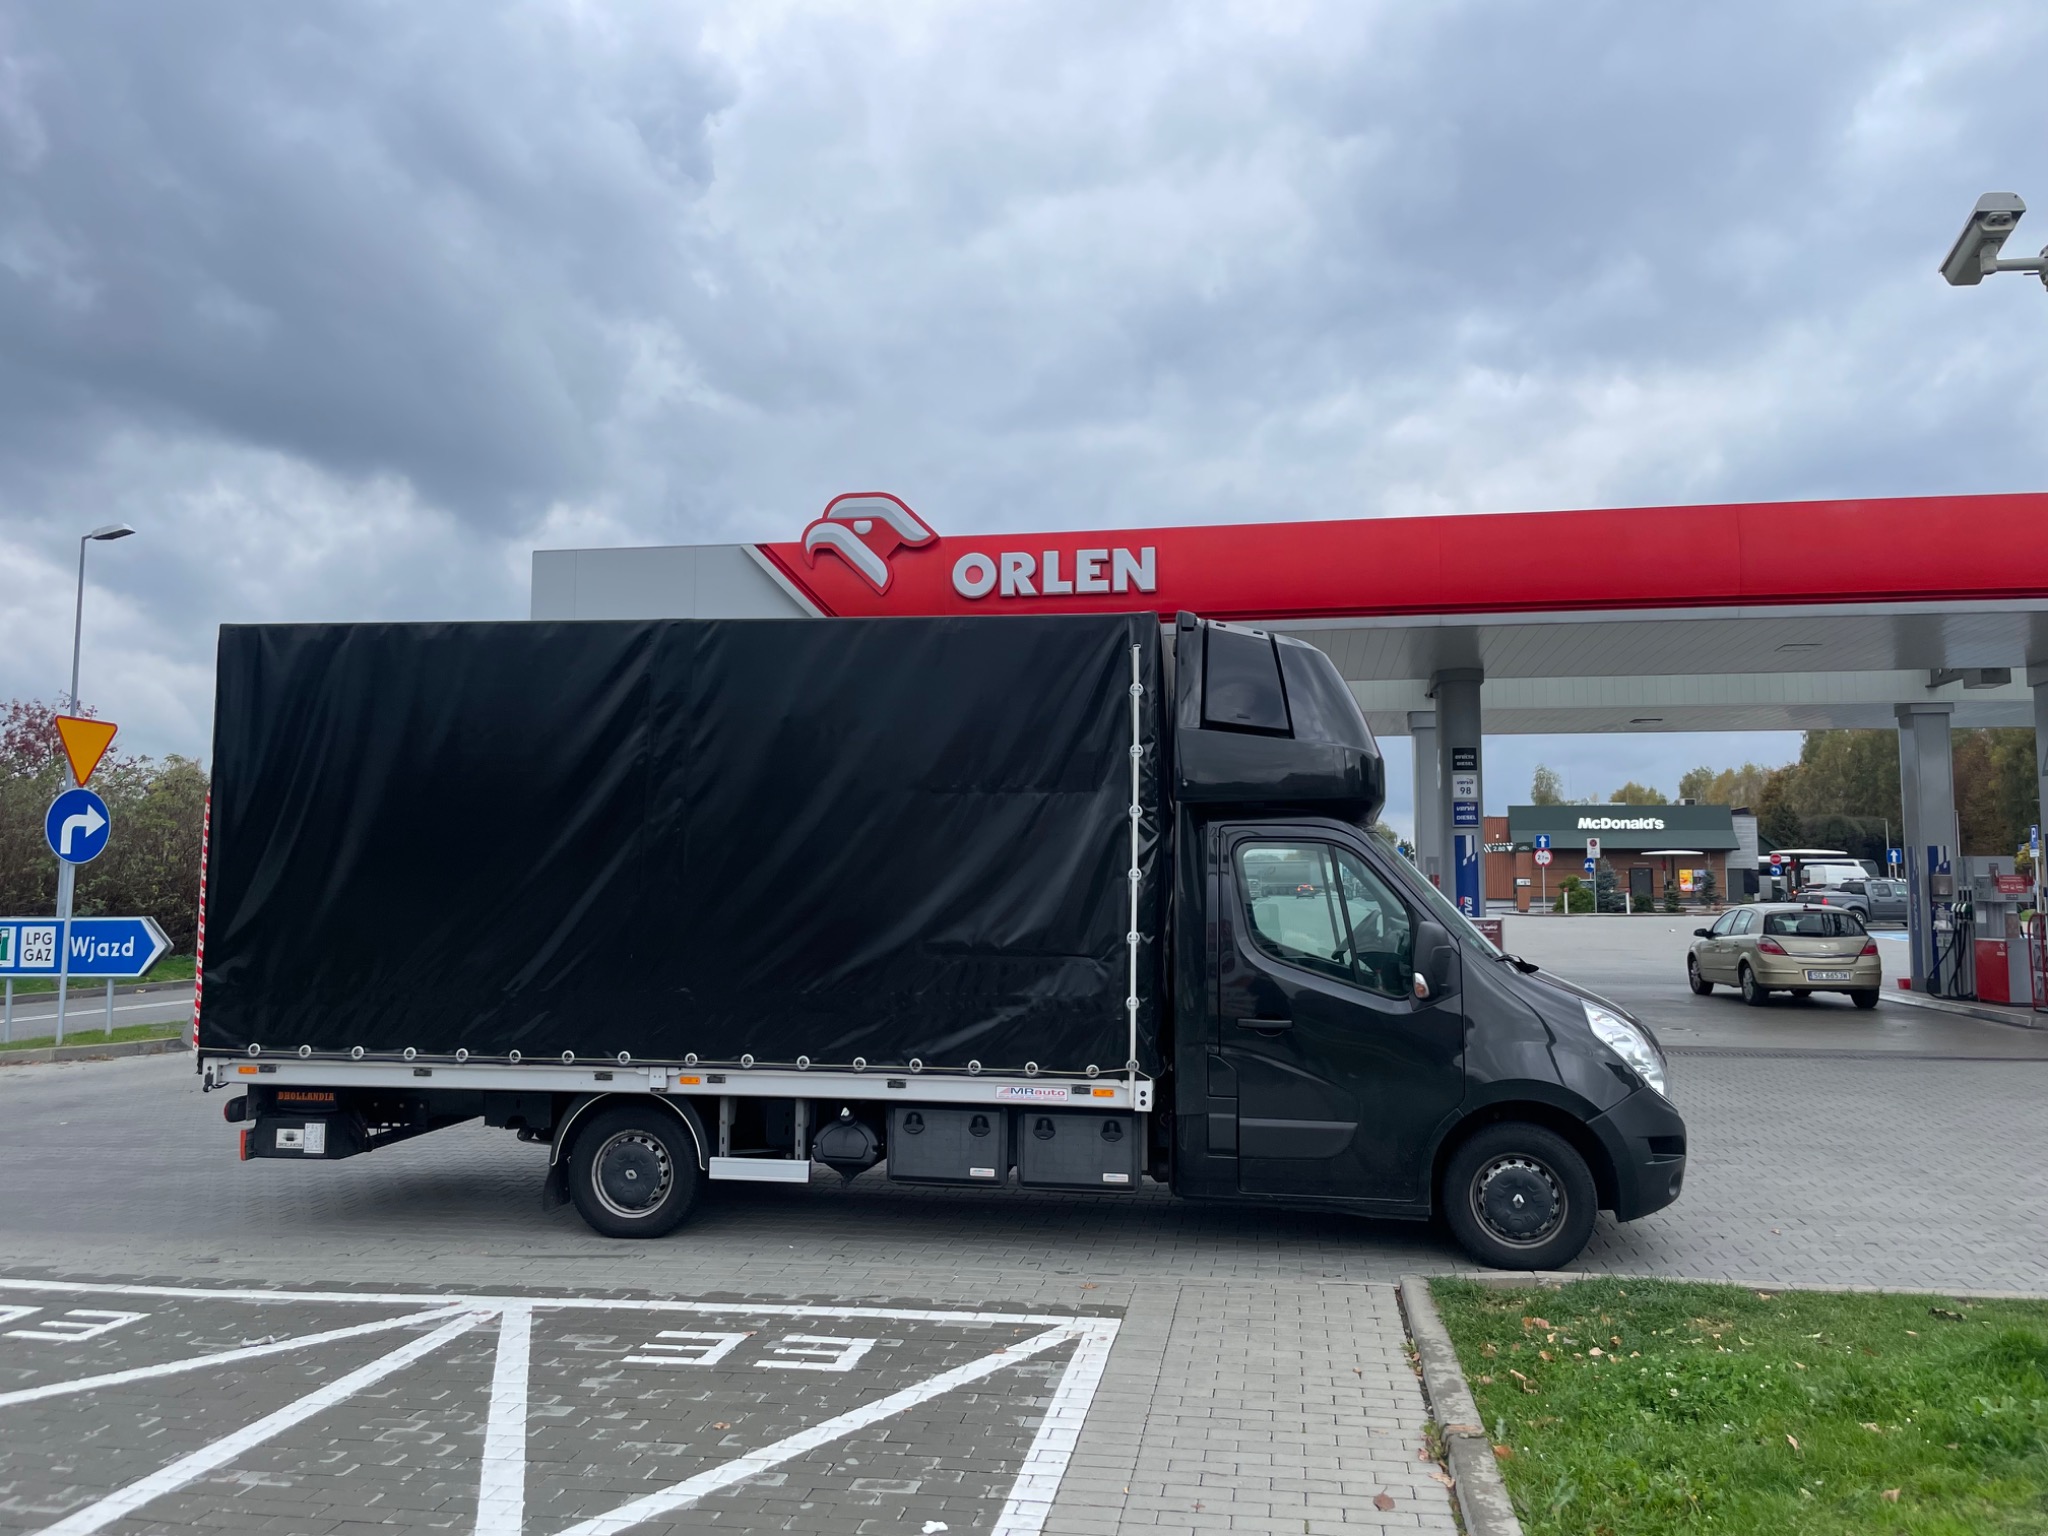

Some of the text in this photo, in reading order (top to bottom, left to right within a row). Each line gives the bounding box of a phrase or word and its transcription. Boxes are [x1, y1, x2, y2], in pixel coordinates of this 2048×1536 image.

[952, 547, 1157, 599] ORLEN
[1459, 787, 1471, 795] 98
[1577, 817, 1665, 830] McDonald's
[26, 932, 53, 946] LPG
[23, 949, 52, 962] GAZ
[70, 936, 135, 963] Wjazd
[277, 1091, 335, 1102] DHOLLANDIA
[1010, 1087, 1066, 1096] MRauto
